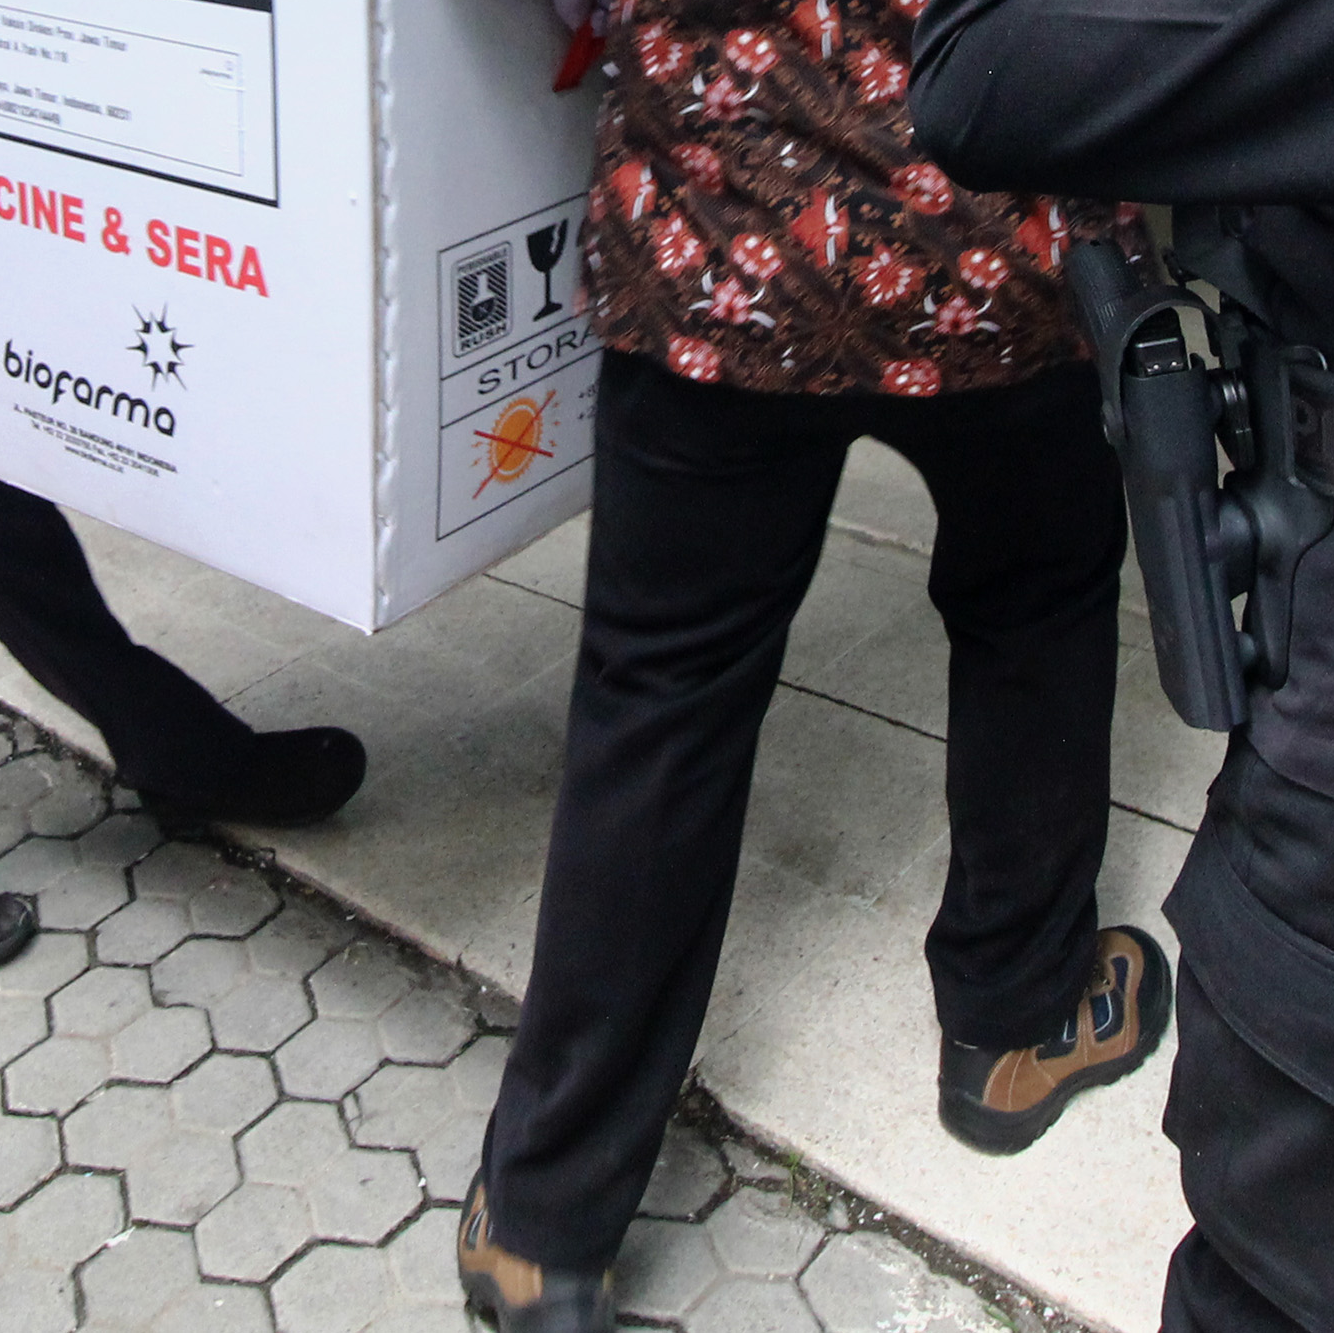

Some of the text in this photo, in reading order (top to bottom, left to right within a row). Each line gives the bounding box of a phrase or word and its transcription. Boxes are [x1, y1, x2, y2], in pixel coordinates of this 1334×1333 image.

[102, 206, 130, 253] &
[147, 218, 270, 297] SERA
[460, 322, 508, 352] RUSH
[4, 339, 175, 437] biofarma
